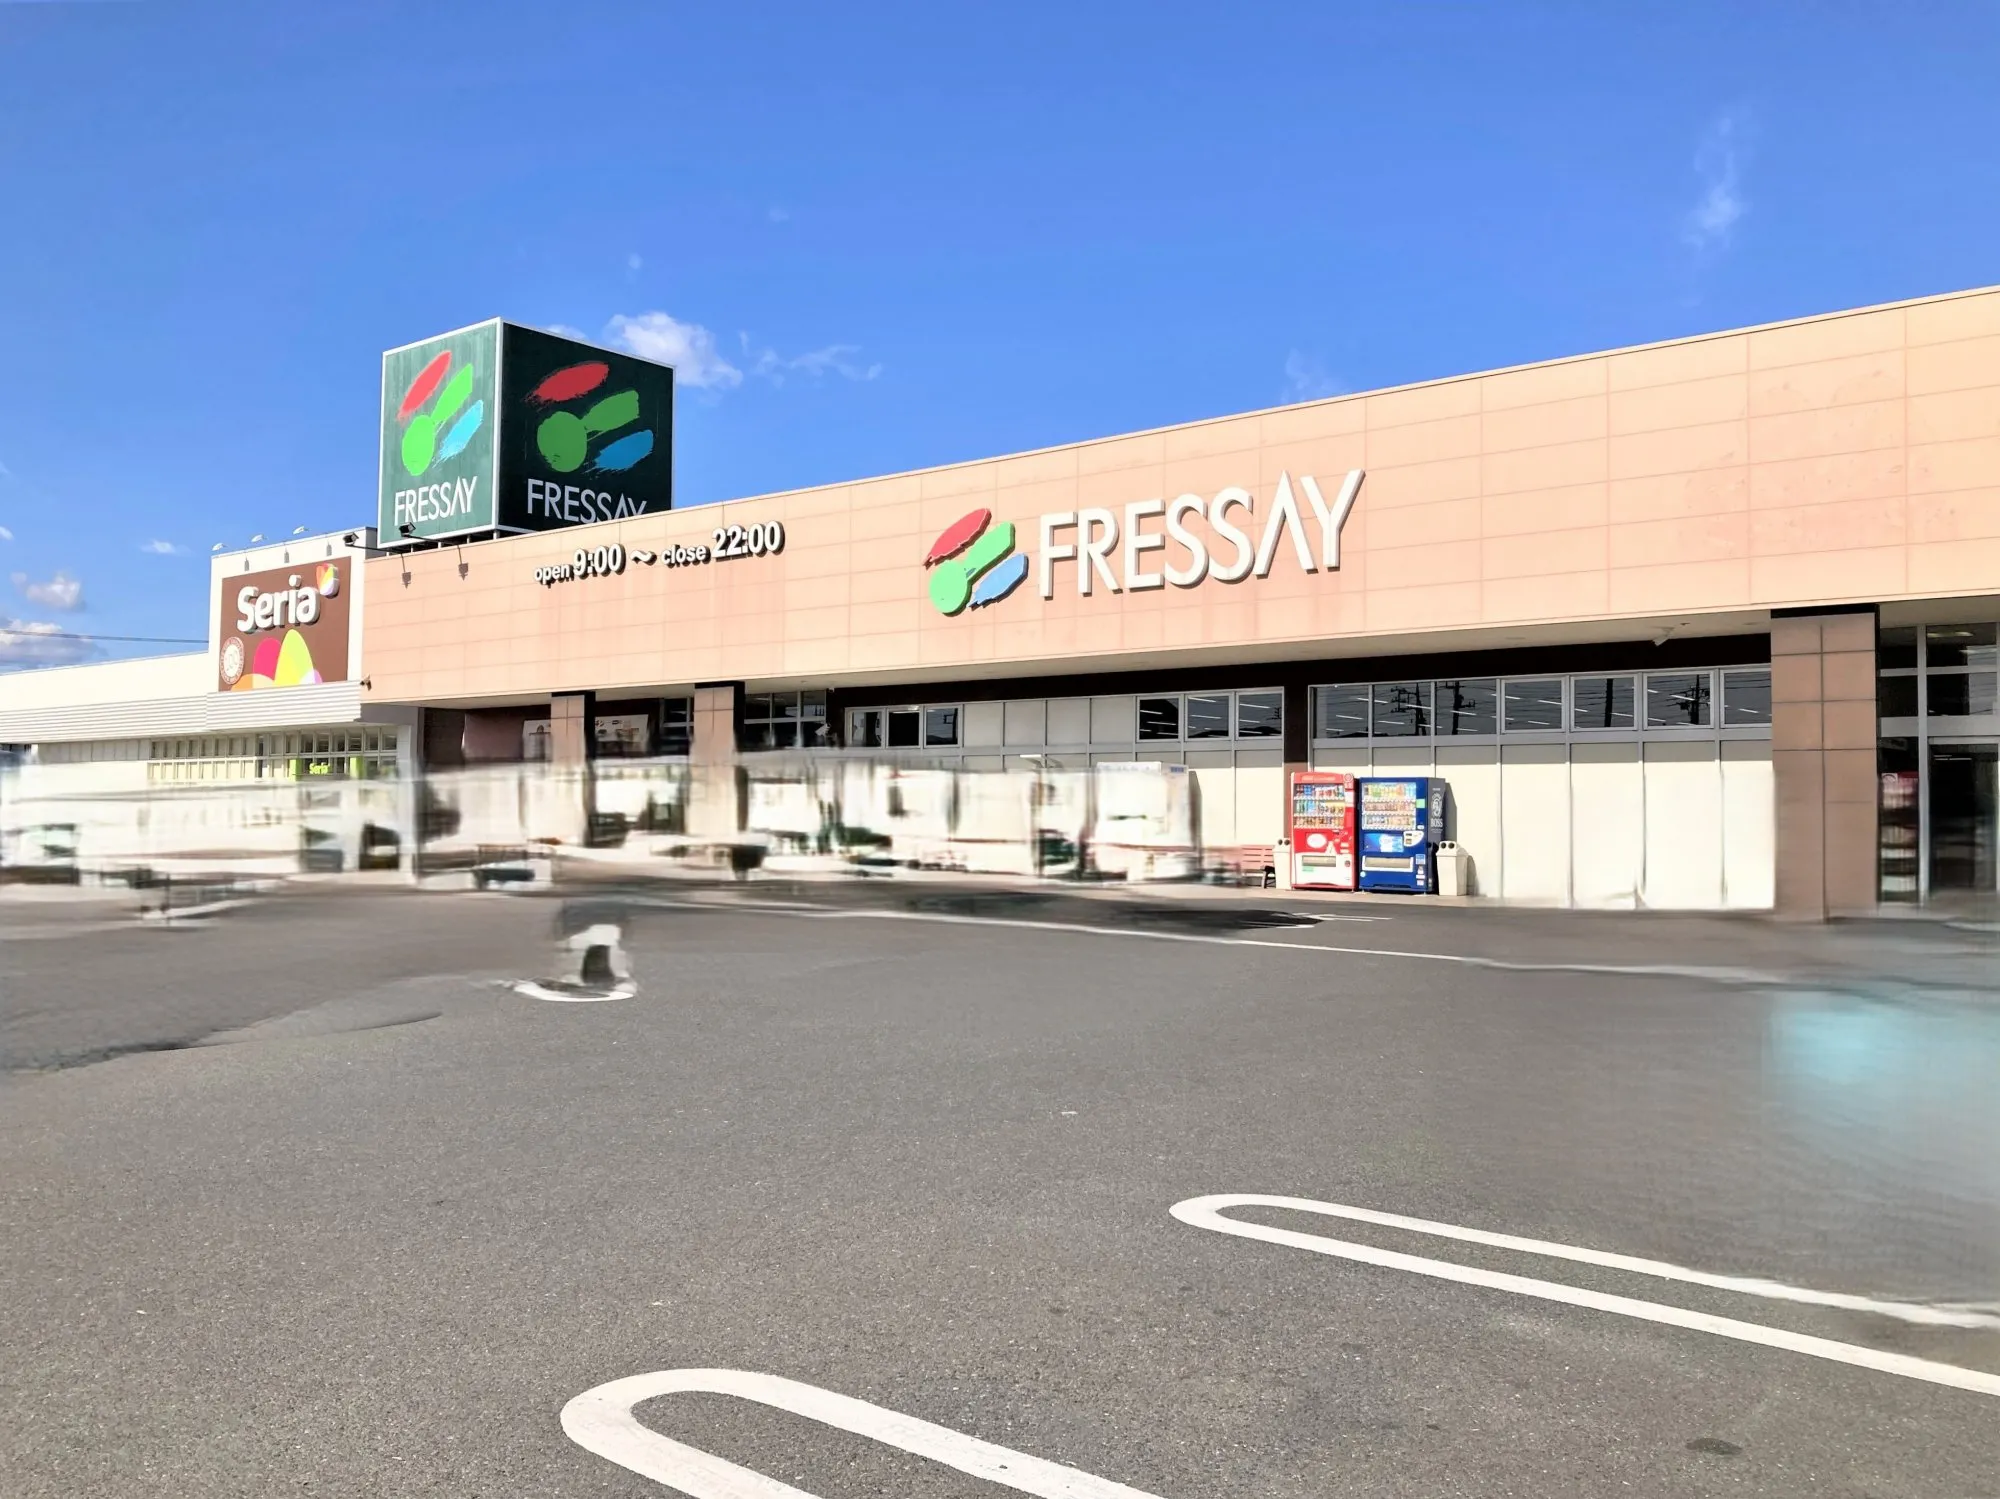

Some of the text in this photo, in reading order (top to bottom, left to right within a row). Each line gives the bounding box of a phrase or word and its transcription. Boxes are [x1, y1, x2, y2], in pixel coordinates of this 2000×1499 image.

[394, 476, 477, 526] FRESSAY
[534, 563, 573, 587] open
[573, 543, 624, 578] 9:00
[660, 544, 708, 567] close
[711, 520, 784, 559] 22:00
[1039, 468, 1365, 600] FRESSAY
[237, 574, 319, 634] Seria
